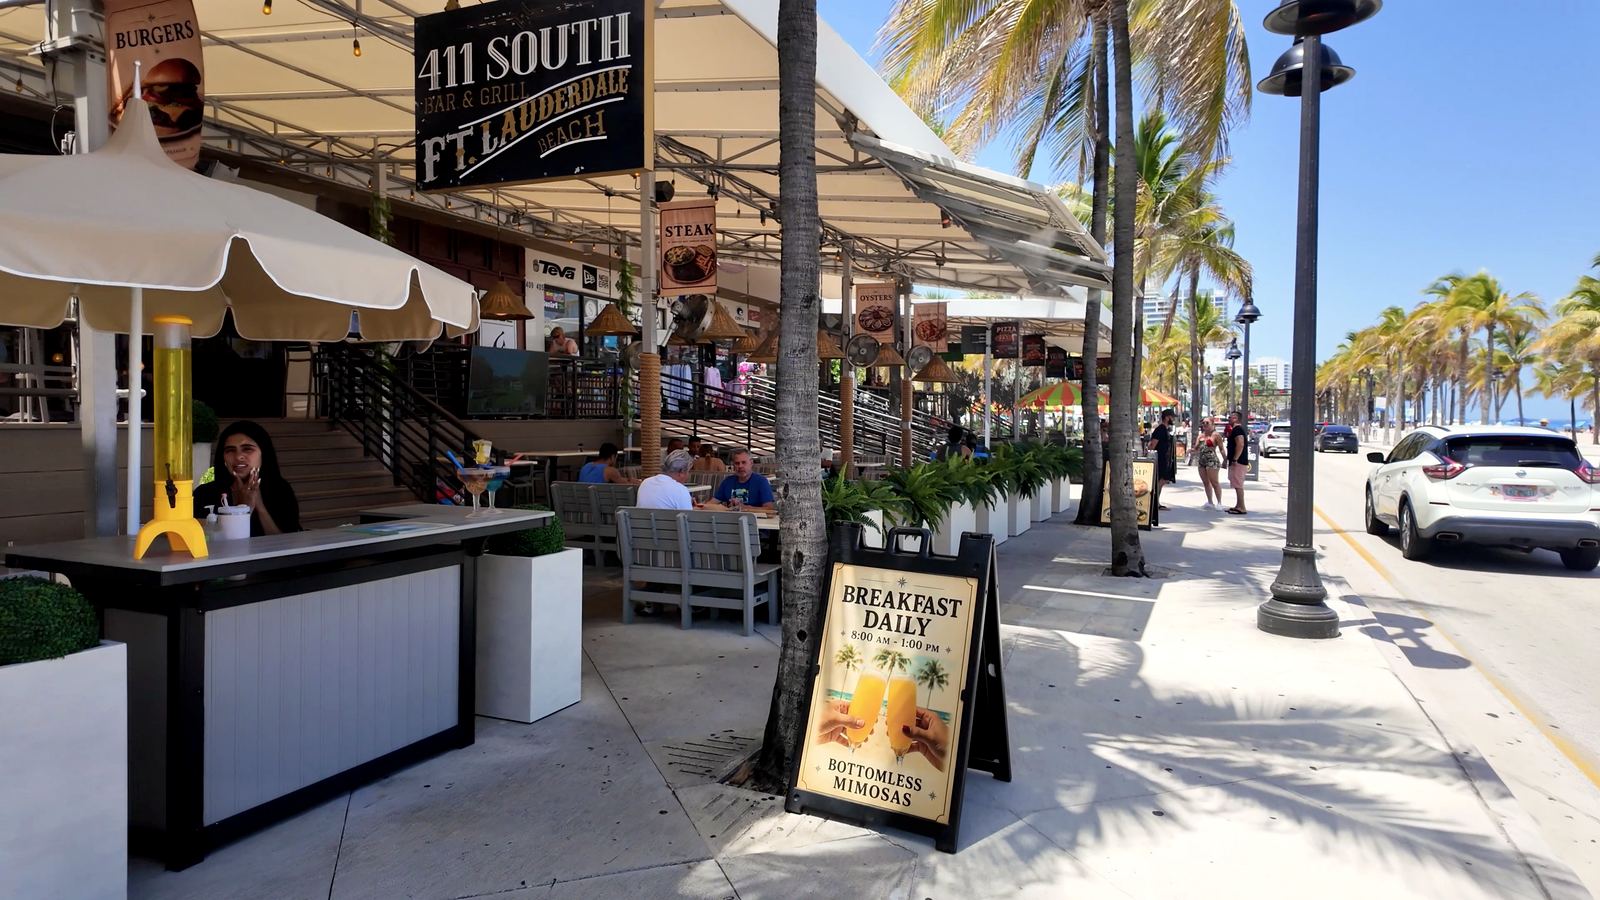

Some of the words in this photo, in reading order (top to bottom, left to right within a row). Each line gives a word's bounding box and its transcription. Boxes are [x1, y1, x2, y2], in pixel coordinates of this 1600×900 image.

[116, 20, 194, 49] BURGERS
[418, 42, 476, 91] 411
[486, 12, 632, 81] SOUTH
[424, 93, 456, 115] BAR
[462, 90, 474, 109] &
[480, 81, 530, 106] GRILL
[421, 126, 478, 183] FT.
[480, 68, 631, 156] LAUDERDALE
[537, 109, 607, 154] BEACH
[665, 223, 714, 238] STEAK
[860, 294, 893, 302] OYSTERS
[996, 326, 1017, 334] PIZZA
[841, 585, 962, 618] BREAKFAST
[863, 609, 932, 637] DAILY
[851, 630, 873, 643] 8:00
[876, 636, 891, 646] AM
[901, 638, 923, 651] 1:00
[926, 643, 940, 654] PM
[828, 758, 923, 792] BOTTOMLESS
[833, 776, 912, 807] MIMOSAS
